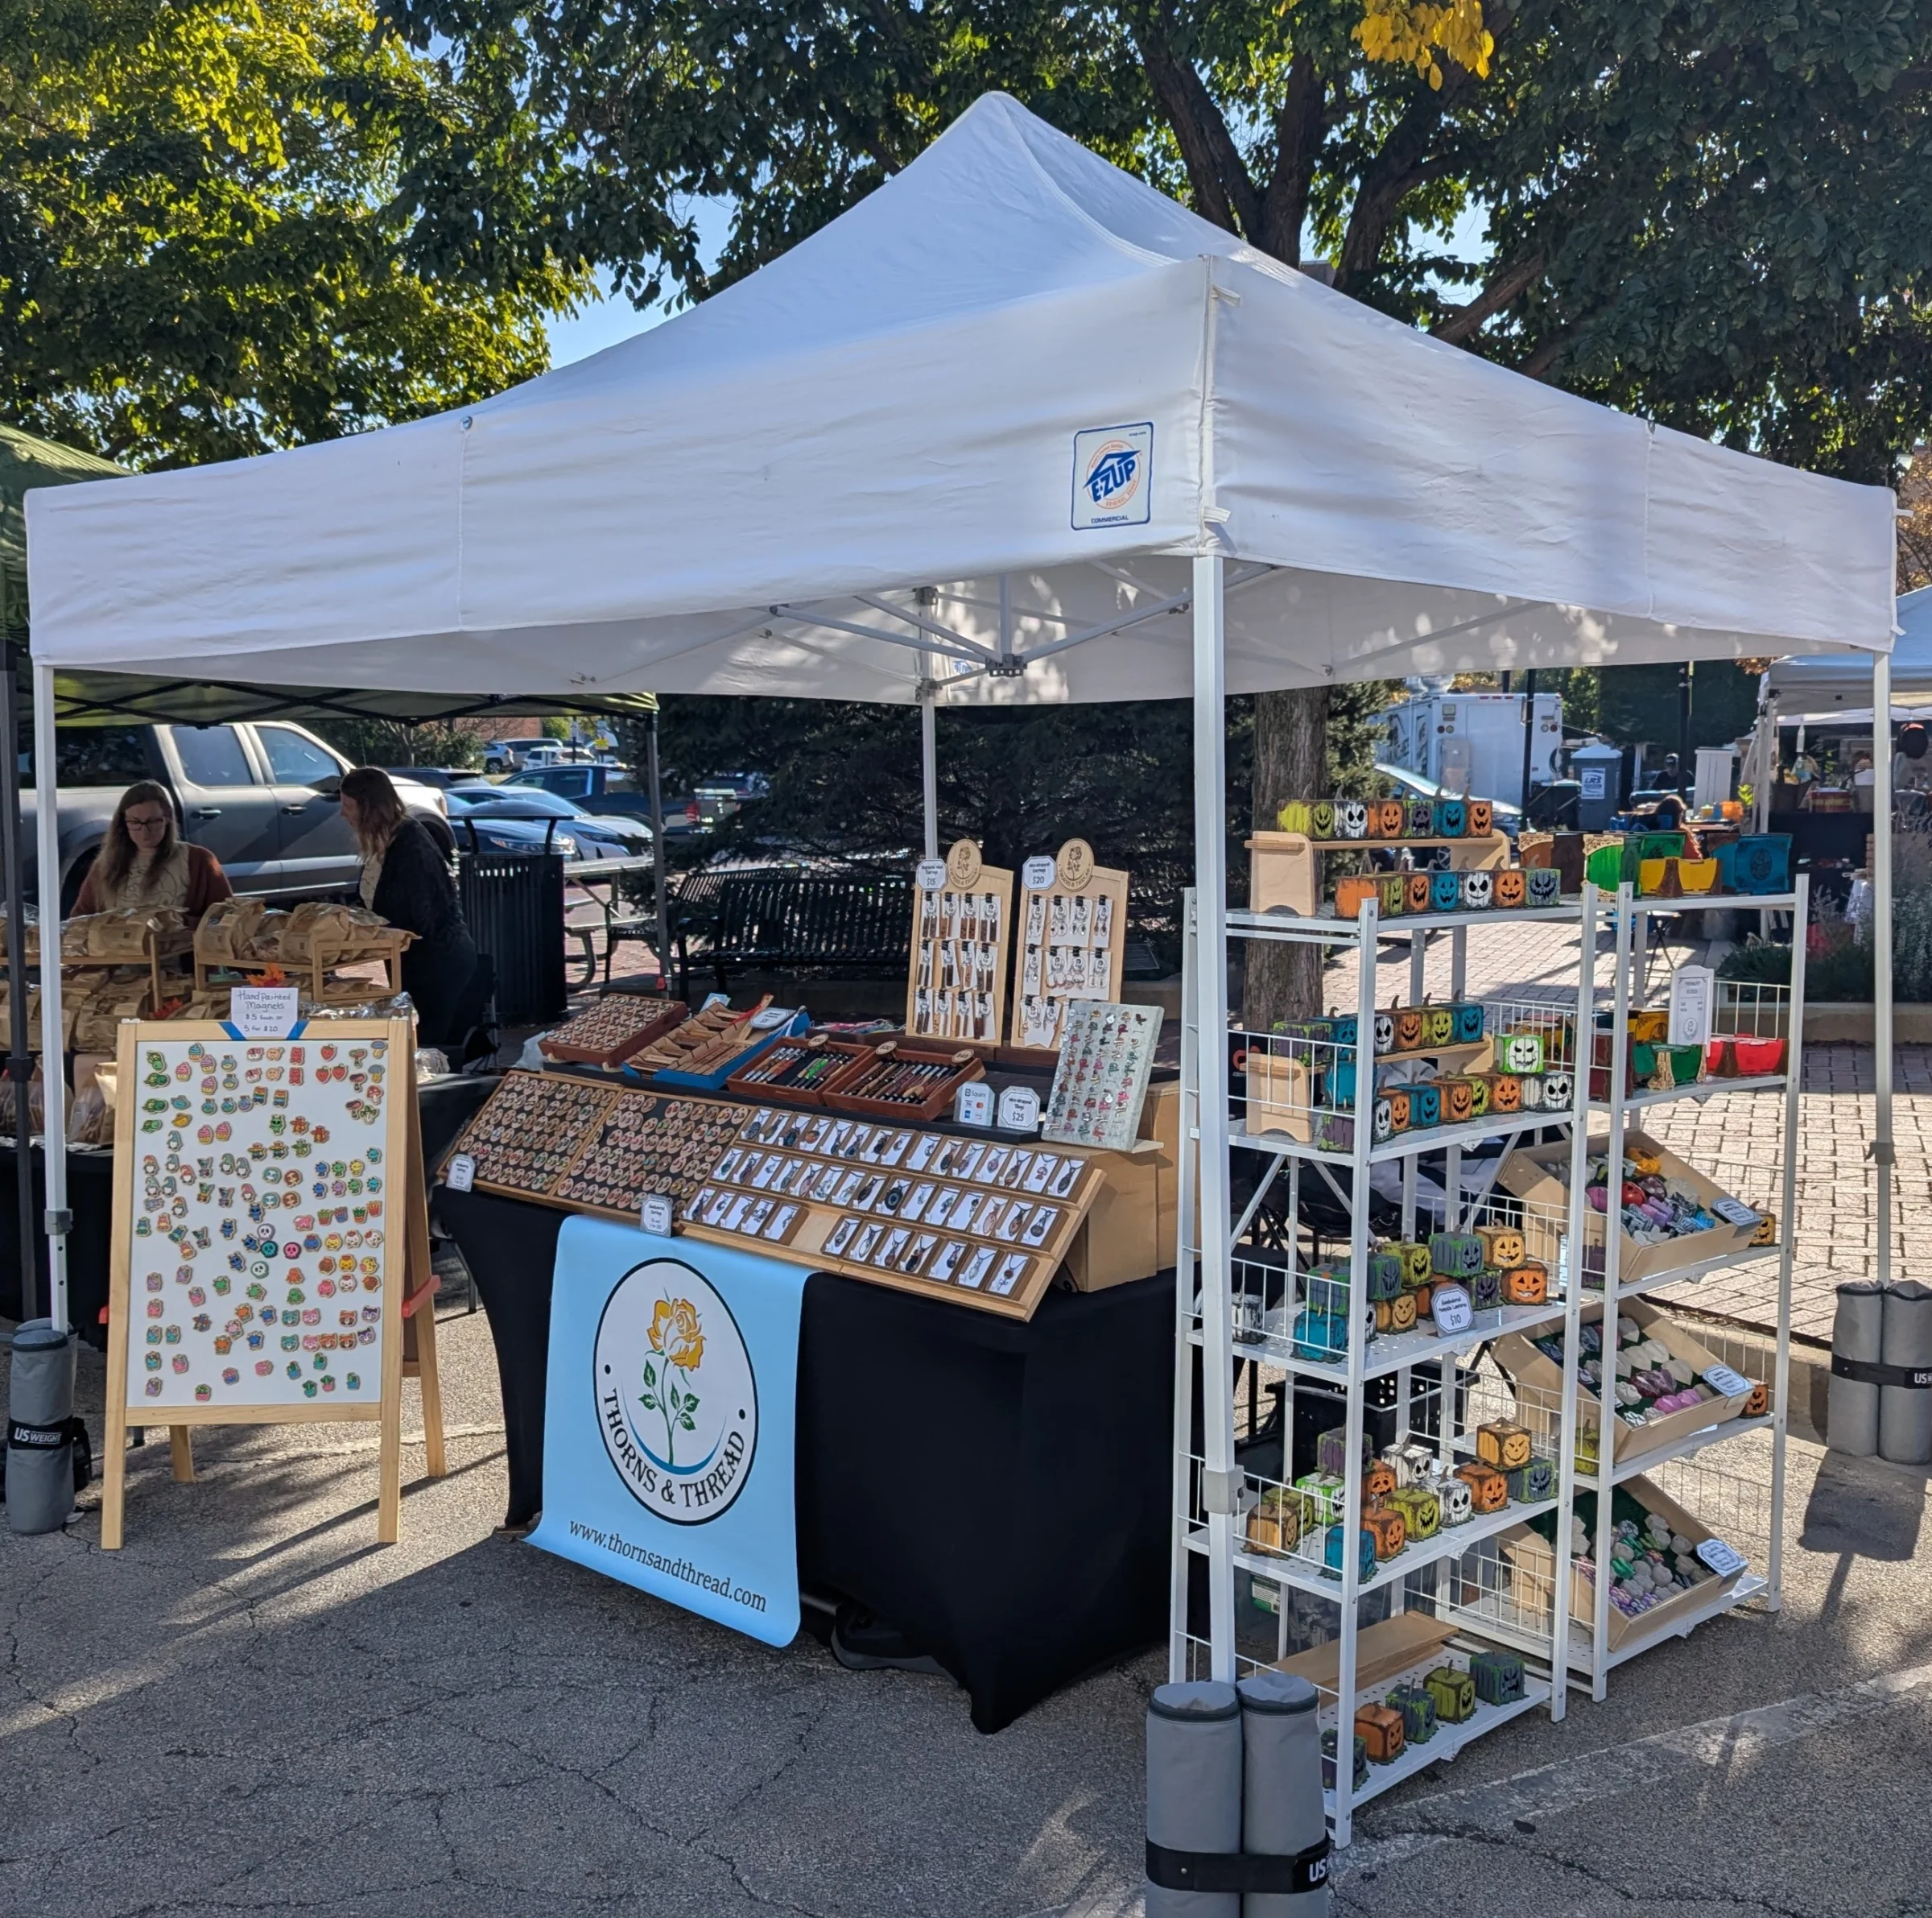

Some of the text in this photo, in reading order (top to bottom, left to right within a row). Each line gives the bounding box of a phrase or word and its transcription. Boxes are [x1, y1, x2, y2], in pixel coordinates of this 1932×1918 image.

[1091, 515, 1129, 523] COMMERCIAL
[927, 878, 936, 887] $15
[1033, 876, 1044, 884] $20
[237, 990, 291, 1002] Hand Painted
[245, 1001, 285, 1012] Magnets
[1012, 1112, 1024, 1122] $25
[1450, 1314, 1462, 1326] $10
[1914, 1373, 1927, 1383] US
[604, 1387, 745, 1507] THORNS & THREAD
[570, 1520, 766, 1612] www.thornsandthread.com
[1310, 1858, 1326, 1882] US
